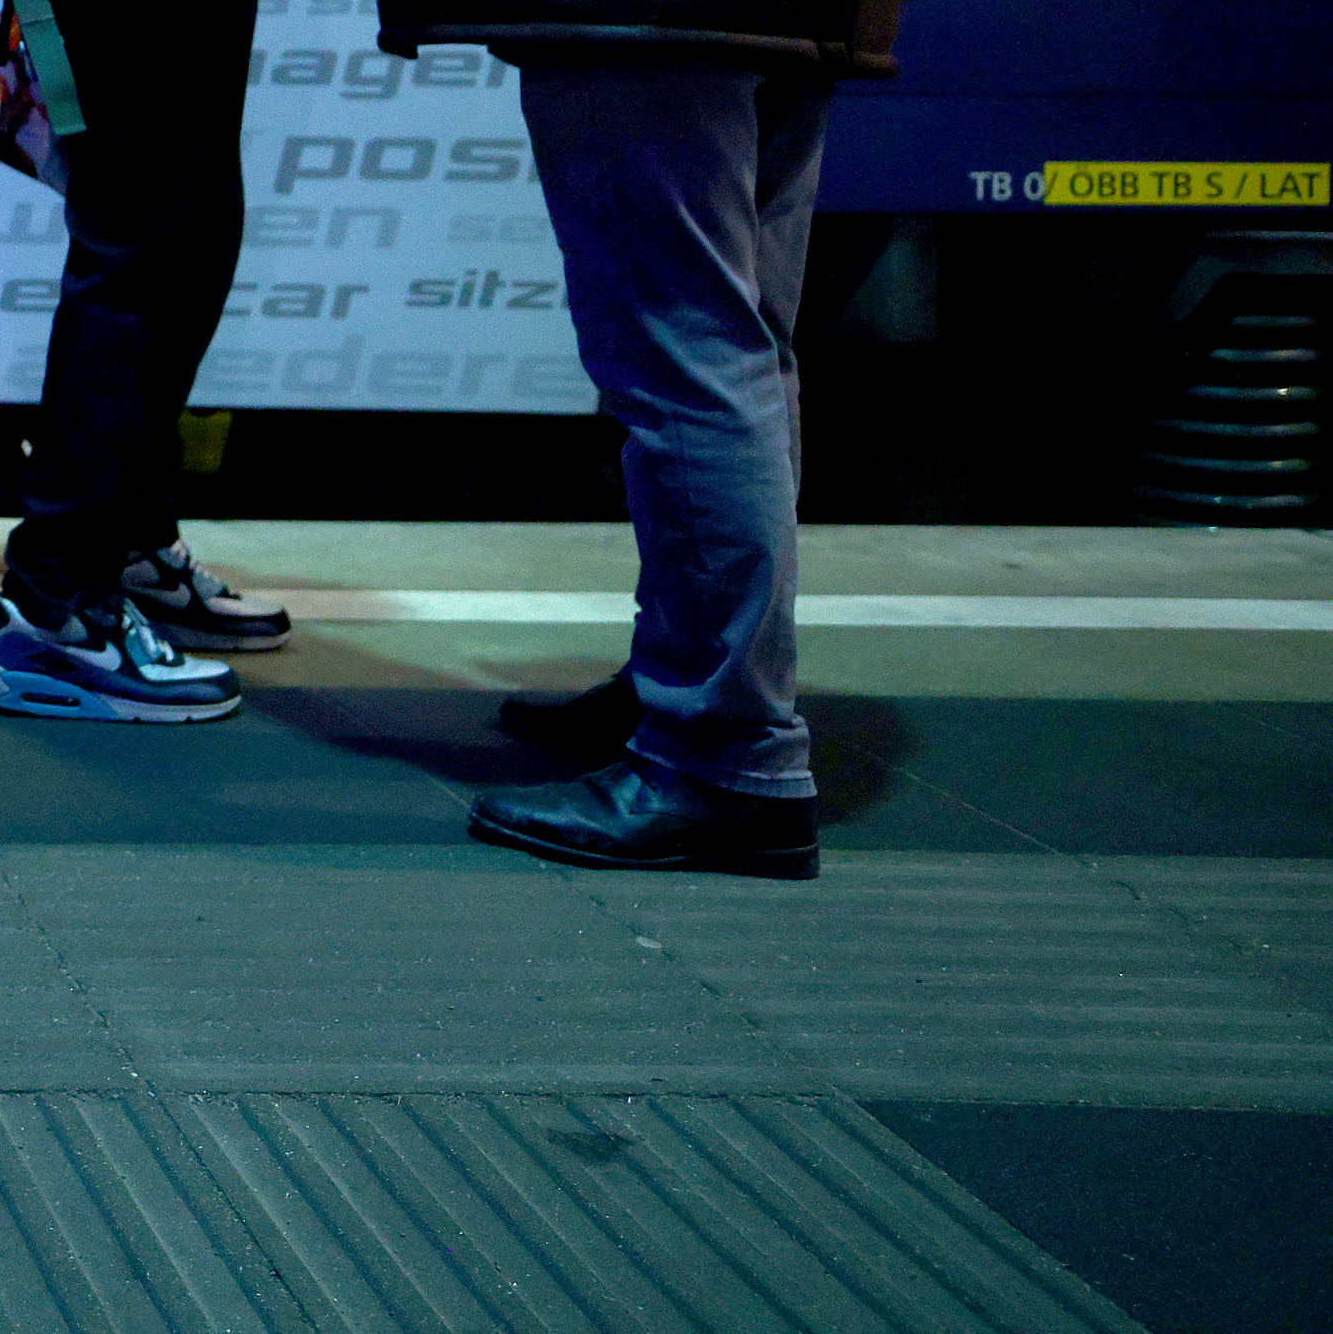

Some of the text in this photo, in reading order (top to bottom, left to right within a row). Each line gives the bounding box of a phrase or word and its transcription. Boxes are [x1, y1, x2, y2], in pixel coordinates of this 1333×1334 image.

[247, 48, 508, 100] age
[274, 135, 539, 196] pos
[968, 171, 1013, 202] TB
[1069, 165, 1140, 199] ÖBB
[1149, 171, 1193, 199] TB
[1205, 171, 1224, 199] S
[1260, 172, 1321, 199] LAT
[405, 269, 568, 309] sitz
